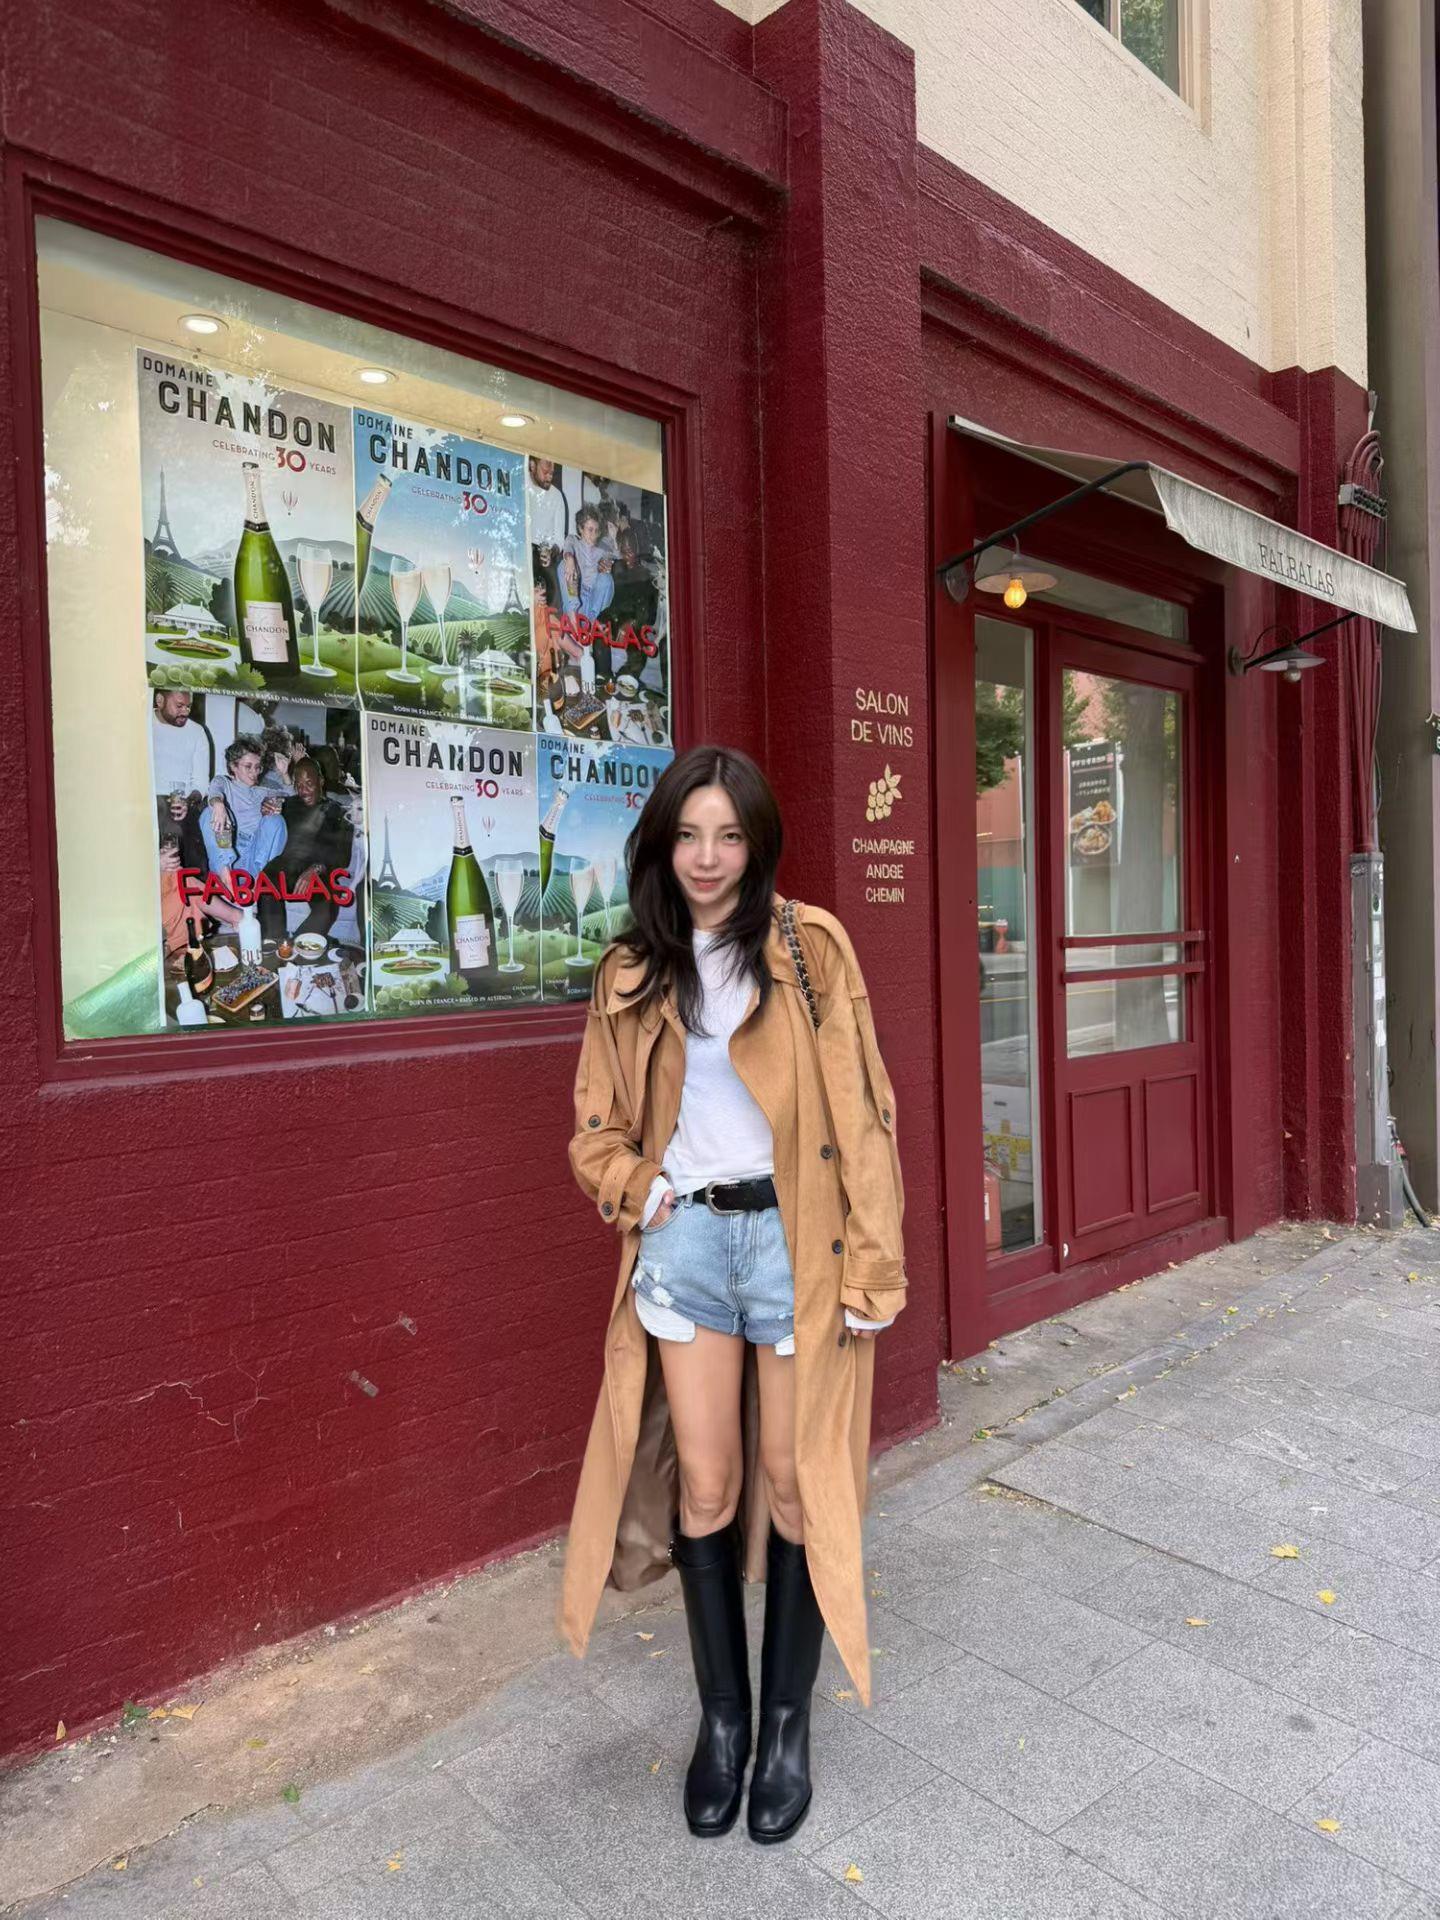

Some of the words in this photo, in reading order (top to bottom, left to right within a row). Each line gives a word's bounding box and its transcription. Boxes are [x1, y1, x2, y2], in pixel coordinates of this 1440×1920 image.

[143, 357, 214, 387] DOMAINE
[158, 381, 336, 453] CHANDON
[357, 414, 414, 440] DOMAINE
[212, 439, 275, 462] CELEBRATING
[275, 446, 307, 472] 30
[310, 462, 337, 476] YEARS
[369, 434, 511, 497] CHANDON
[462, 490, 488, 514] 30
[855, 687, 909, 716] SALON
[371, 719, 426, 737] DOMAINE
[851, 719, 873, 743] DE
[877, 722, 914, 748] VINS
[383, 737, 523, 777] CHANDON
[541, 739, 586, 755] DOMAINE
[425, 781, 476, 793] CELEBRATING
[475, 778, 500, 799] 30
[502, 788, 524, 797] YEARS
[852, 837, 915, 855] CHAMPAGNE
[176, 867, 356, 907] FABALAS
[865, 886, 905, 903] CHEMIN
